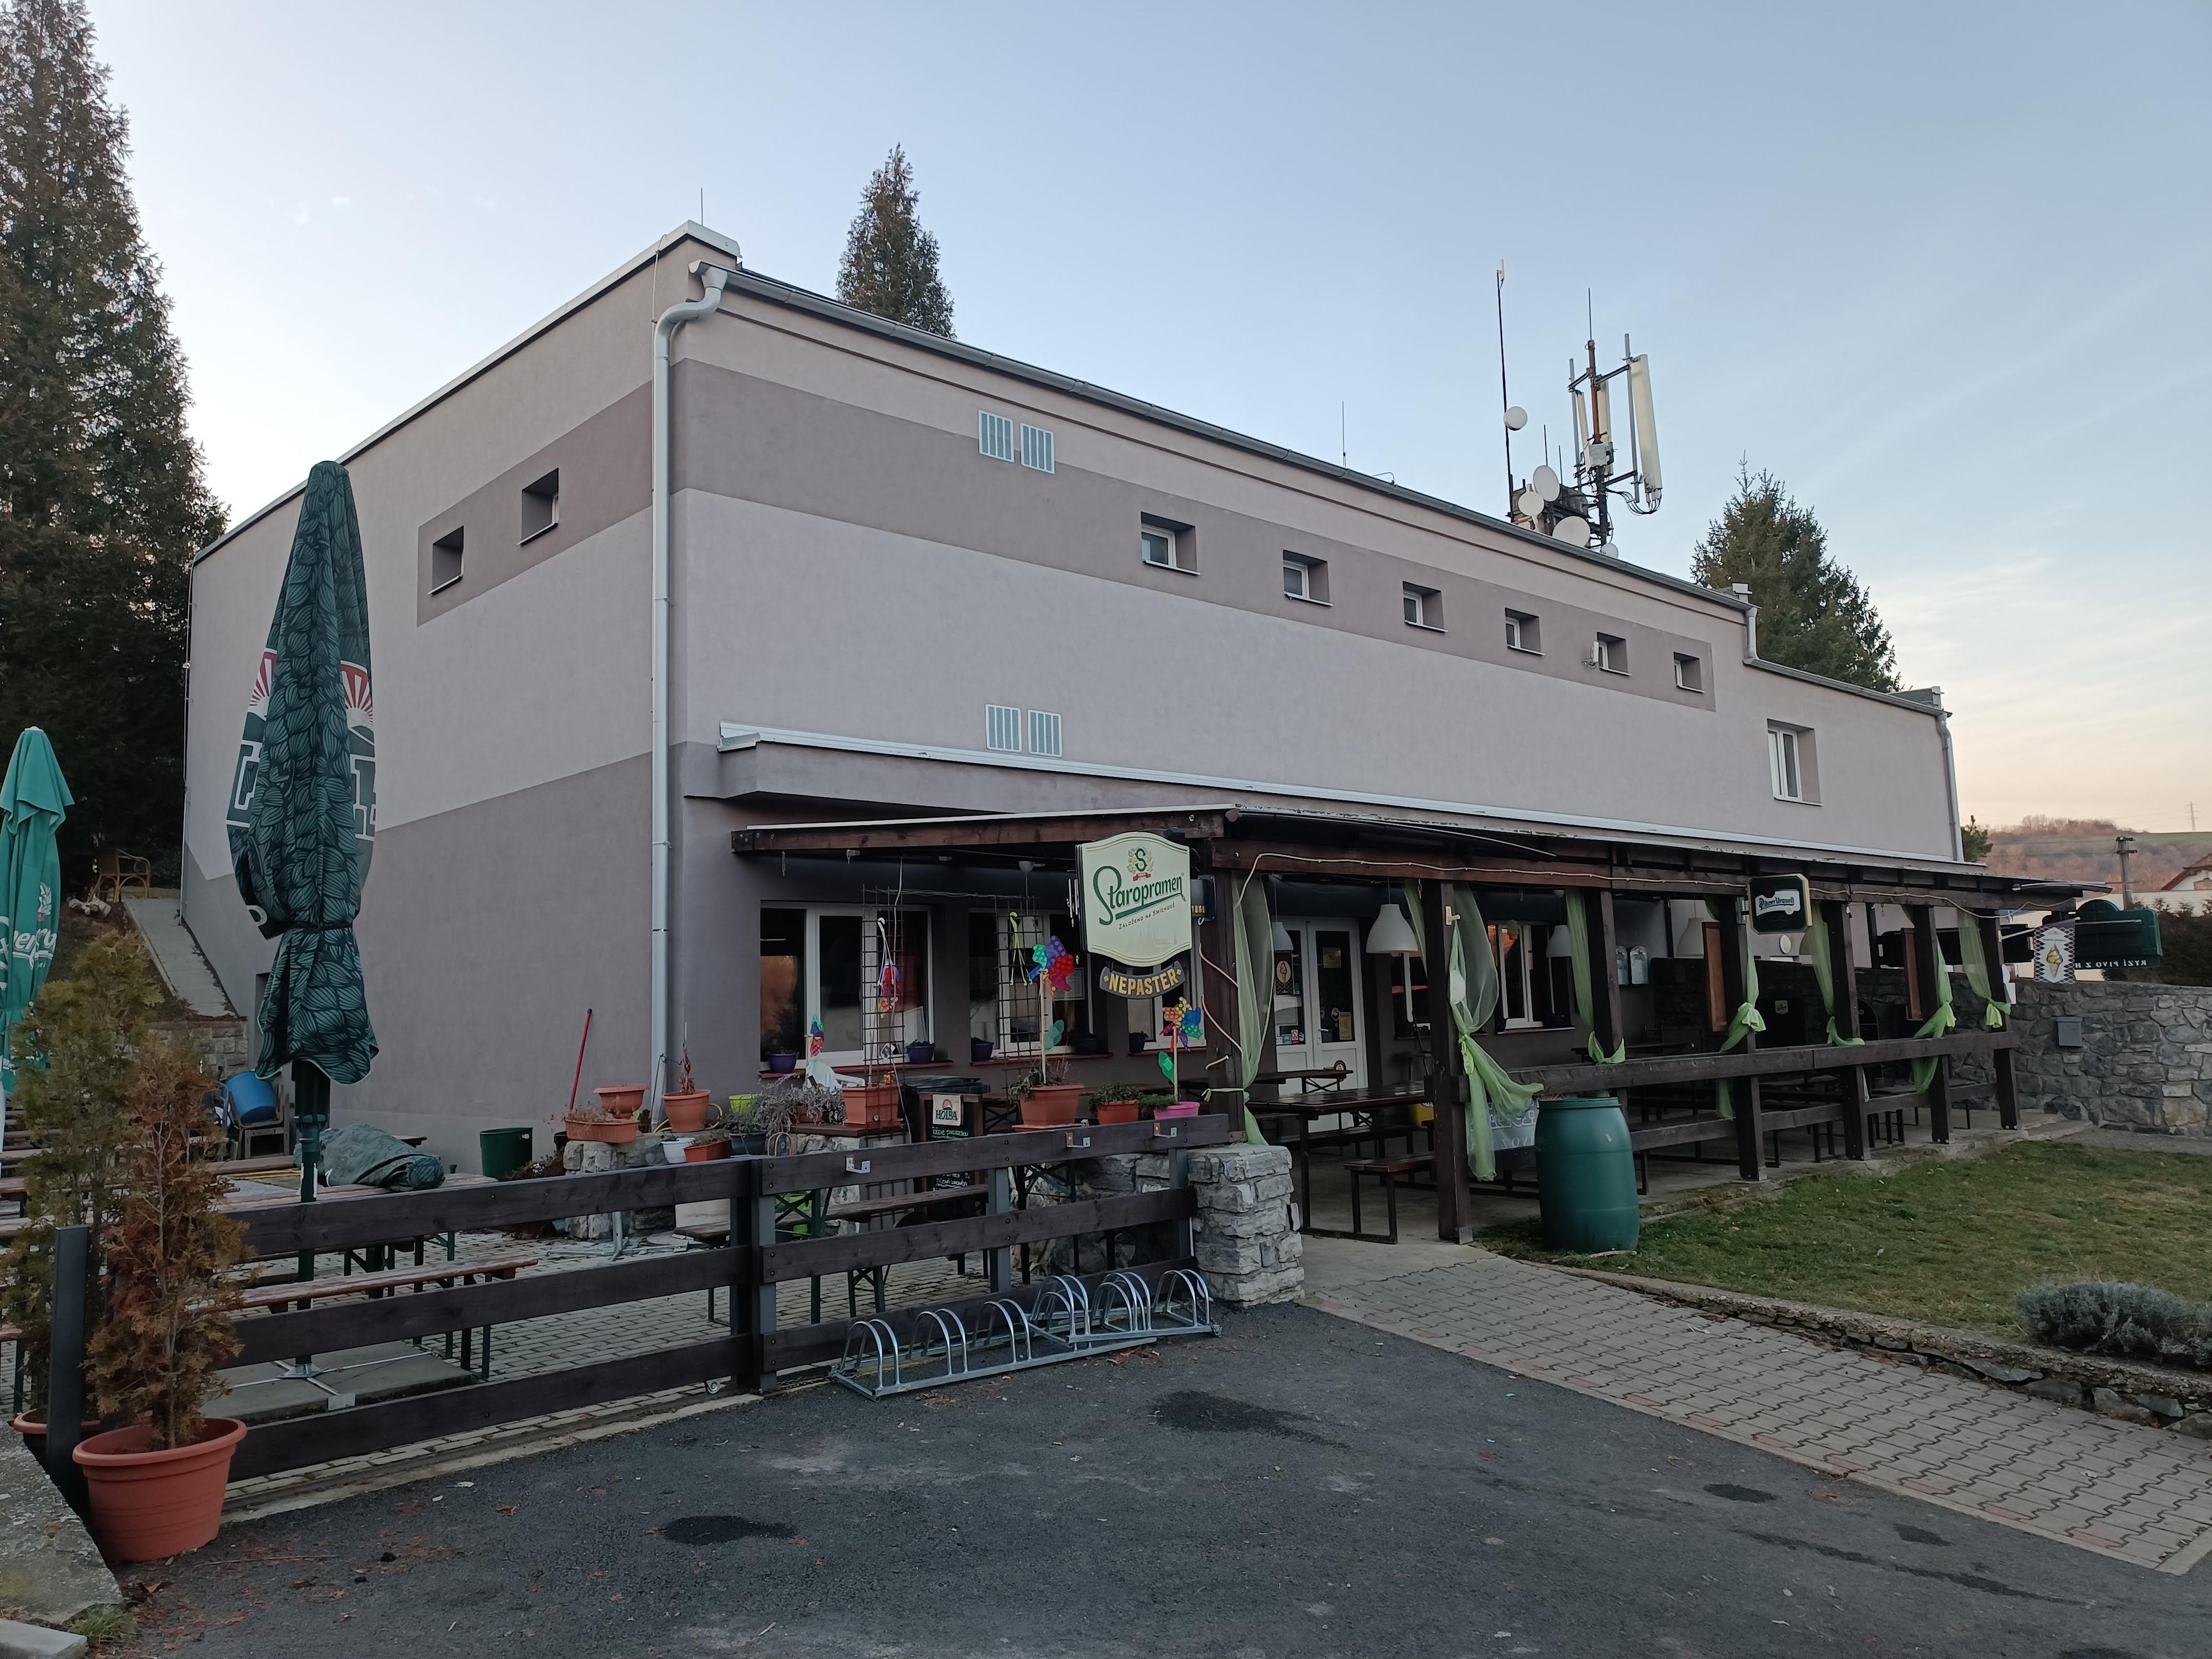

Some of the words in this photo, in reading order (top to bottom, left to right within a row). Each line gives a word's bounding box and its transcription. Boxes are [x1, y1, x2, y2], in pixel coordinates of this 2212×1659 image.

[1093, 865, 1183, 926] Staropramen
[1108, 968, 1179, 996] NEPASTER
[935, 1110, 958, 1121] HOLBA
